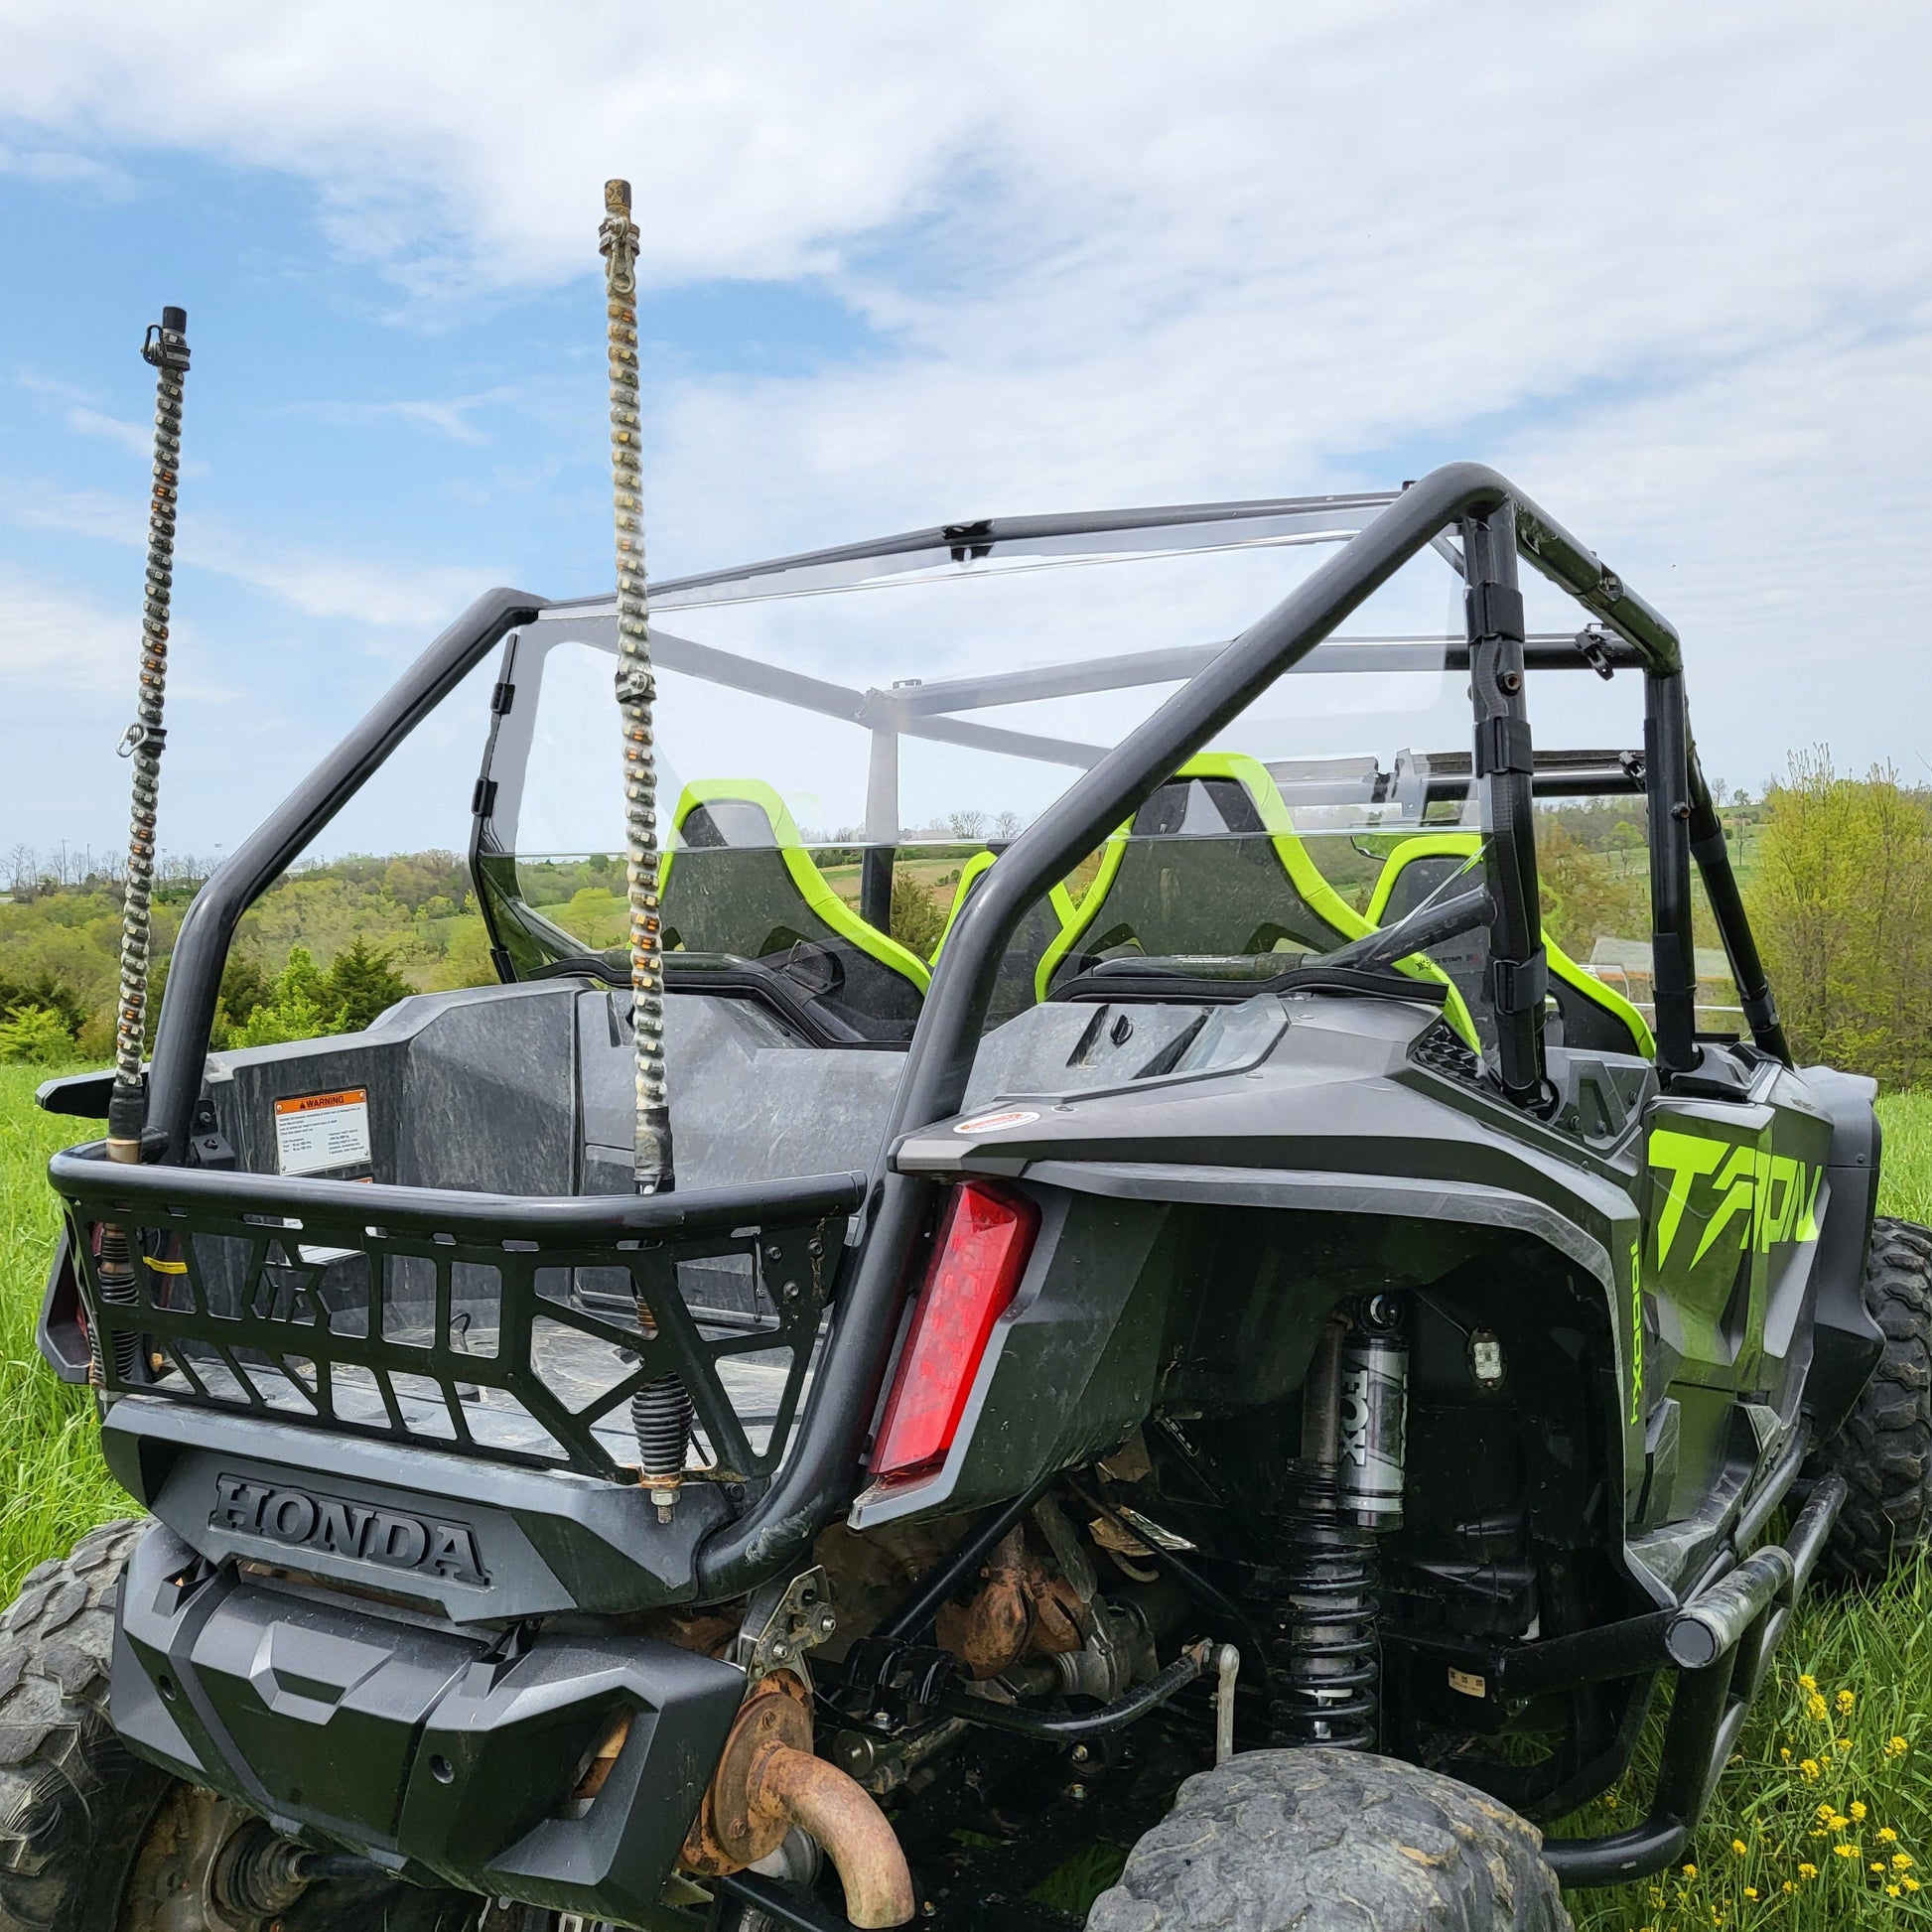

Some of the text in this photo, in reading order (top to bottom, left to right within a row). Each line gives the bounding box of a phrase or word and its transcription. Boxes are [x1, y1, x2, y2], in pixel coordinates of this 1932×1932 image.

[307, 1096, 345, 1108] WARNING
[1341, 1370, 1369, 1466] FOX
[209, 1478, 490, 1587] HONDA
